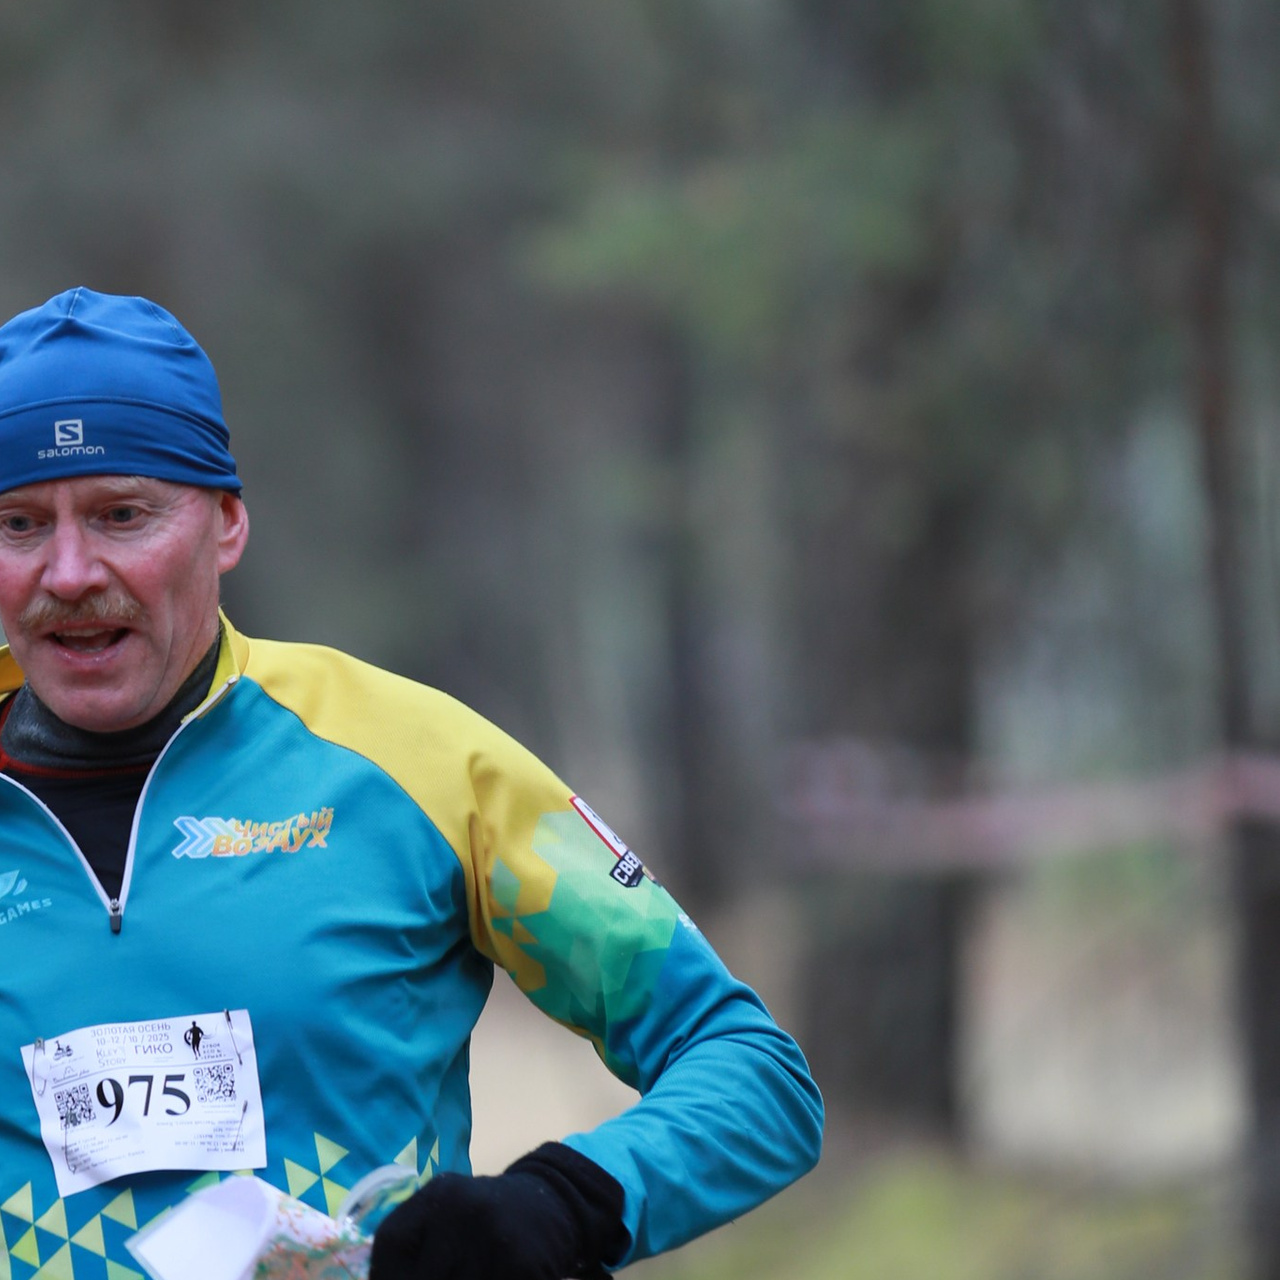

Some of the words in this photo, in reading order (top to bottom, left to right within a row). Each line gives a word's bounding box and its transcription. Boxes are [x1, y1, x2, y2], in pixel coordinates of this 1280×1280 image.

[91, 1026, 135, 1038] ЗОЛОТАЯ
[138, 1022, 171, 1033] ОСЕНЬ
[148, 1033, 170, 1042] 2025
[134, 1043, 173, 1055] ГИКО
[95, 1073, 192, 1128] 975
